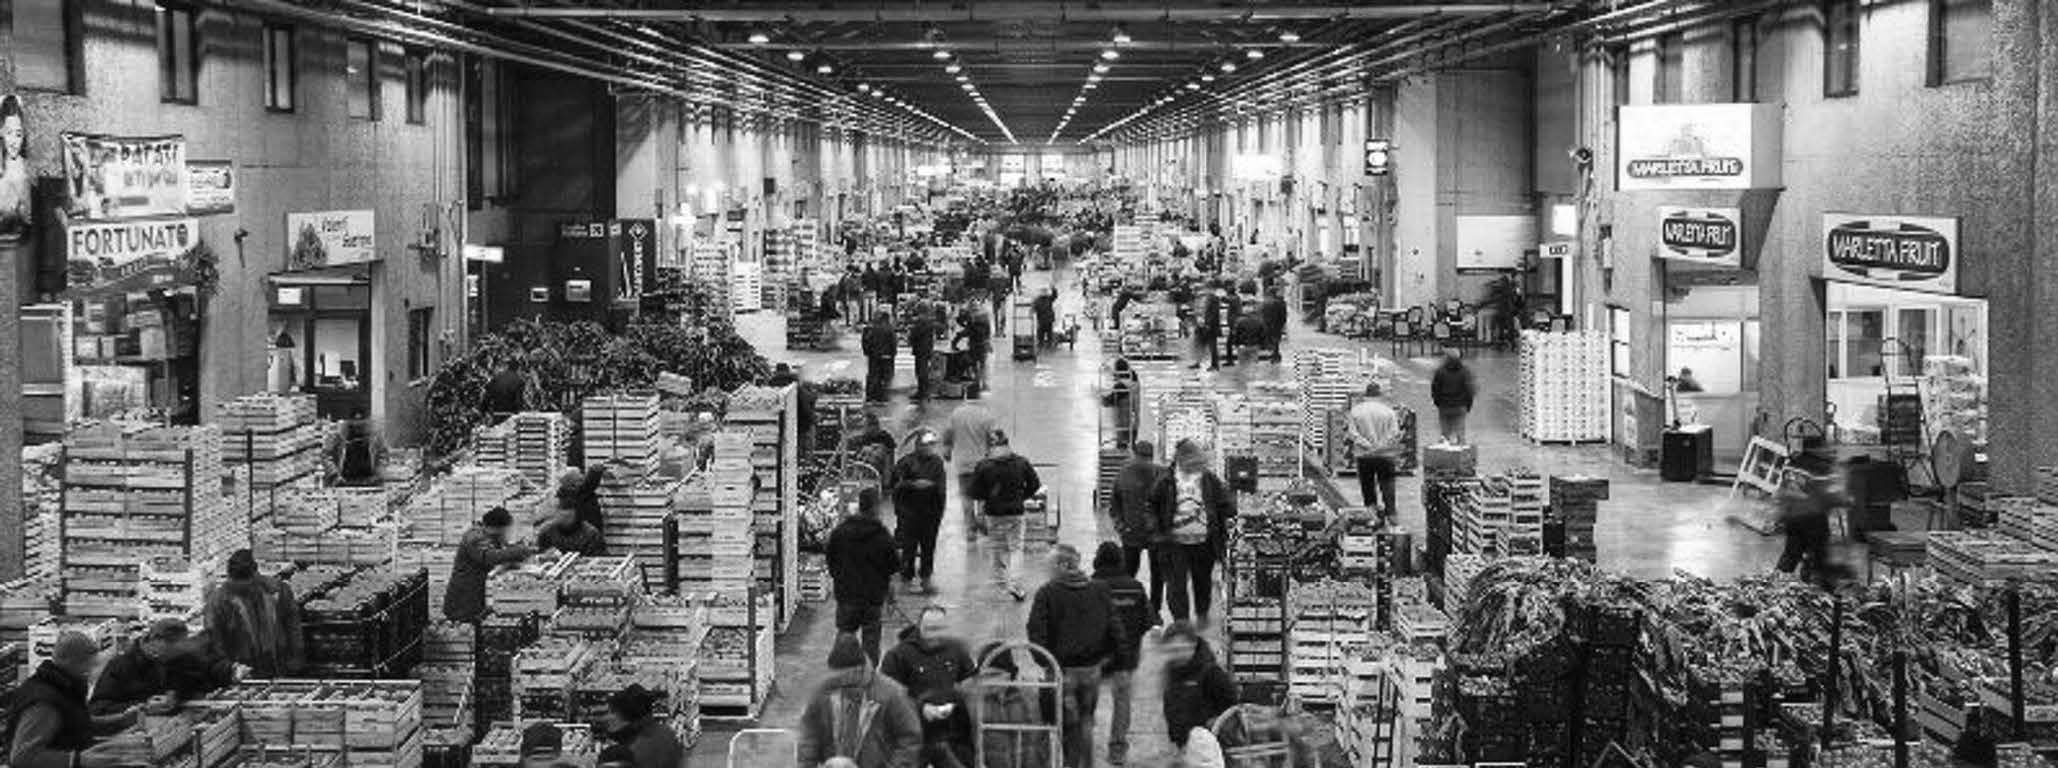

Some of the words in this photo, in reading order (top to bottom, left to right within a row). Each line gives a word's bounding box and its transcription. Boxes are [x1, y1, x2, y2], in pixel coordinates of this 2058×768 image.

[1632, 160, 1698, 176] MARLETTA
[72, 223, 189, 255] FORTUNATO
[1665, 222, 1705, 243] MARLETTA
[1706, 224, 1732, 245] FRUIT
[1833, 234, 1898, 263] MARLETTA
[1900, 240, 1941, 266] FRUIT
